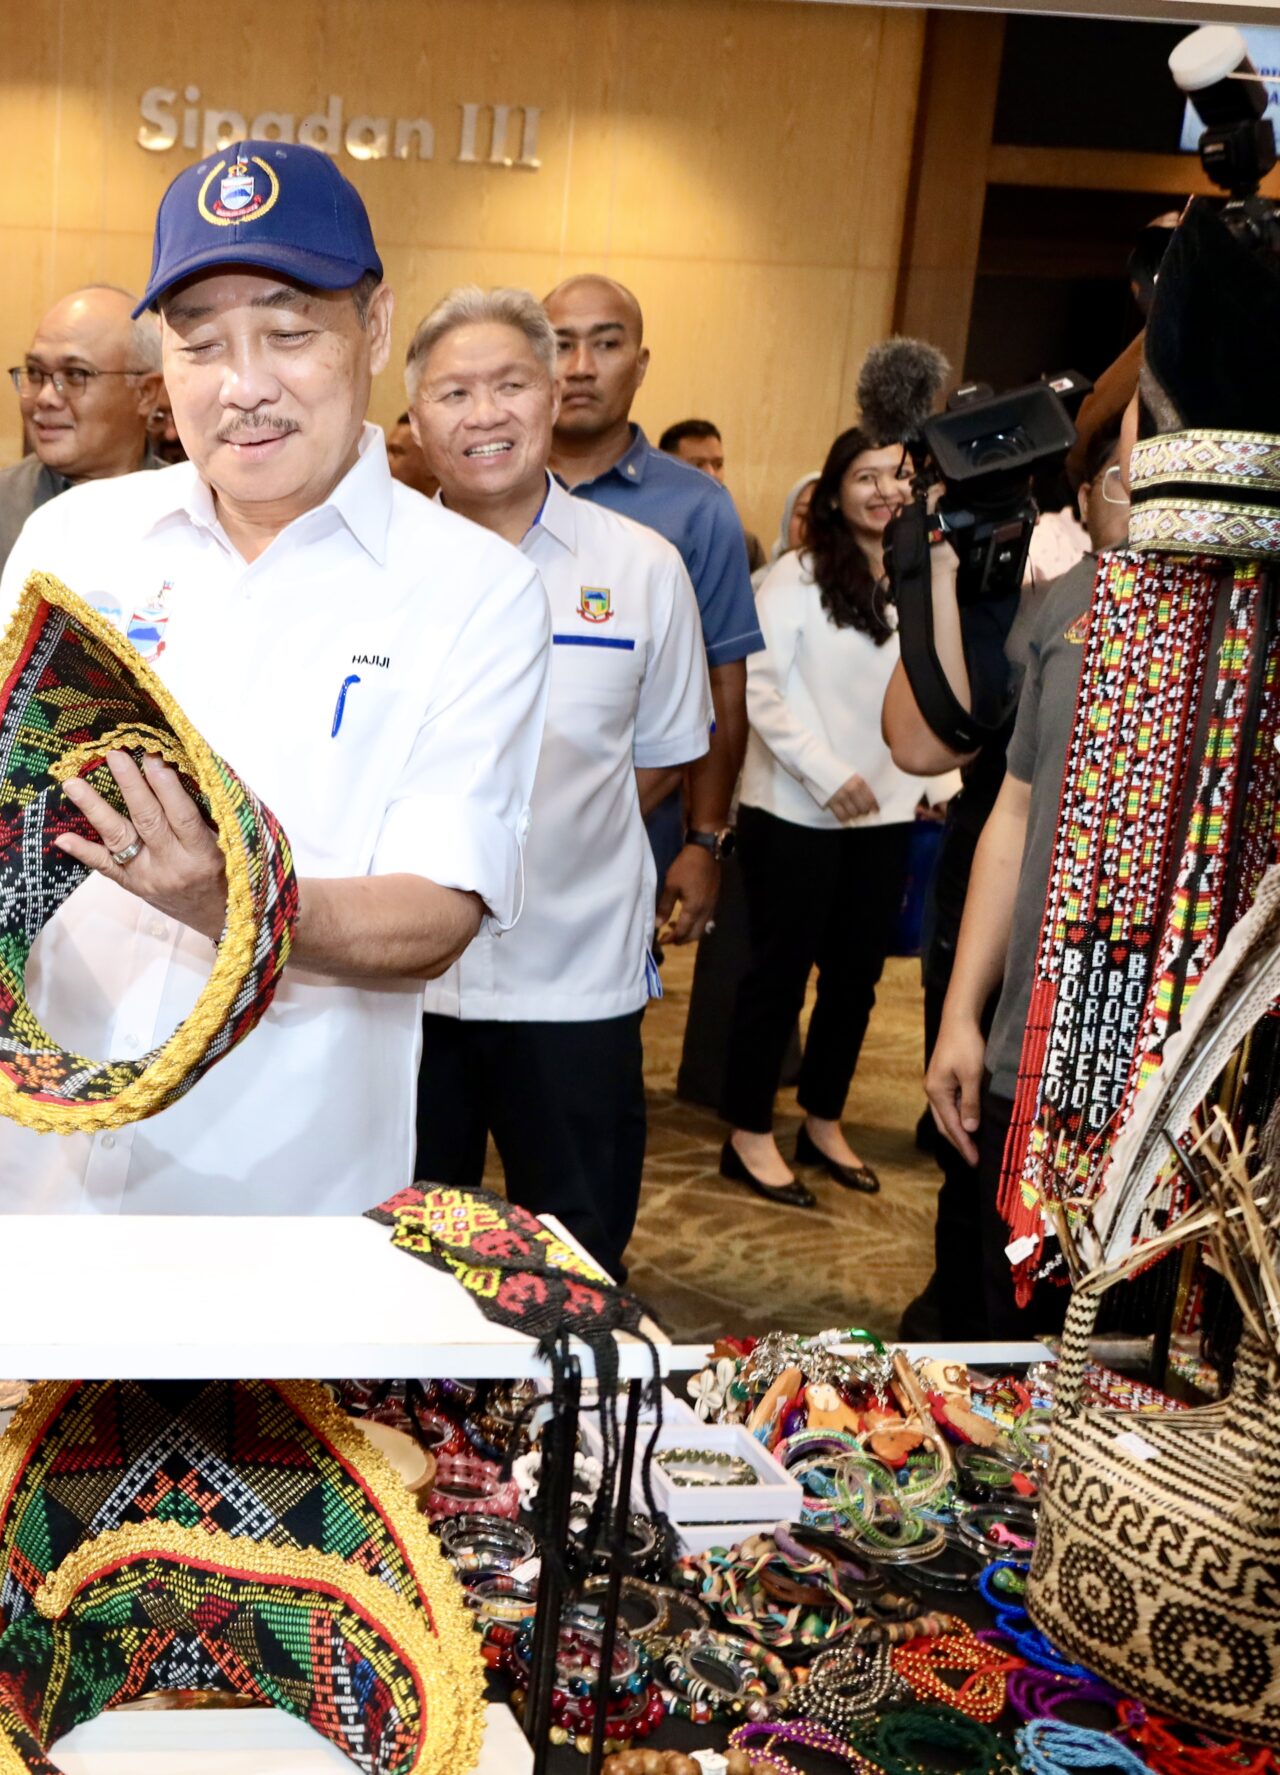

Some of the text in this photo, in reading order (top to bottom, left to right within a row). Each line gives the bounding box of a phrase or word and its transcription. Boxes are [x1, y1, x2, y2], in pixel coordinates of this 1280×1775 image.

[137, 85, 542, 168] Sipadan III
[351, 654, 390, 669] HAJIJI
[1045, 948, 1083, 1102] BORNEO
[1071, 940, 1107, 1109] BORNEO
[1088, 970, 1124, 1129] BORNEO
[1111, 953, 1147, 1108] BORNEO
